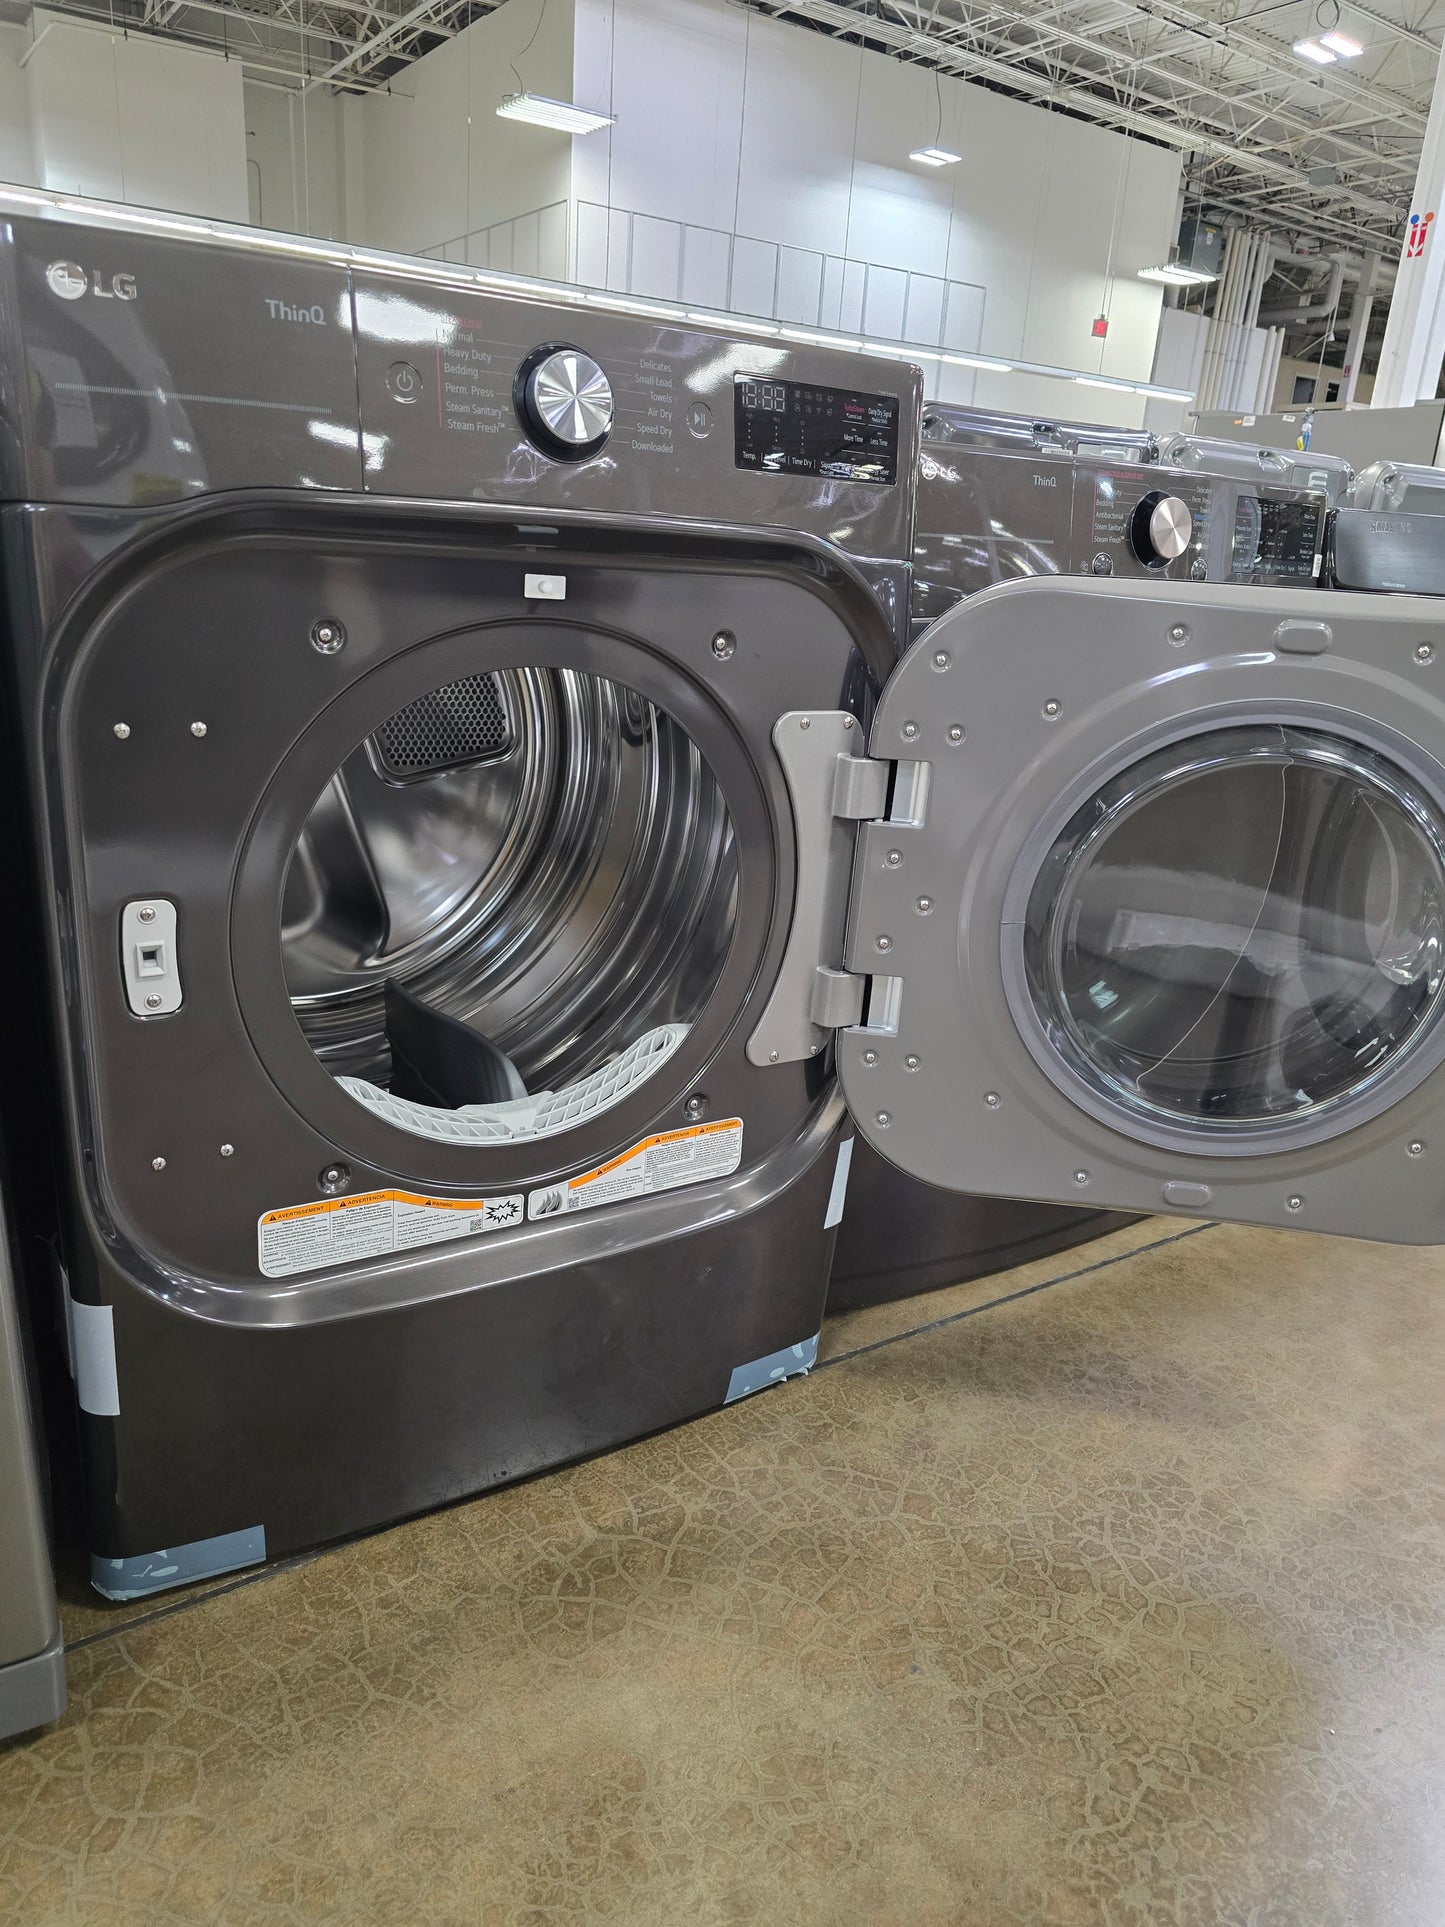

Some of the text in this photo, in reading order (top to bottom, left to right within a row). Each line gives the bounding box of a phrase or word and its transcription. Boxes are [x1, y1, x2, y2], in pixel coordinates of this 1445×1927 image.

[93, 270, 137, 300] LG
[265, 299, 327, 325] ThinQ
[443, 347, 493, 364] Heavy Duty
[443, 362, 479, 379] Bedding
[640, 358, 672, 373] Delicates
[634, 373, 673, 389] Small Load
[445, 382, 495, 398] Perm. Press
[649, 390, 673, 404] Towels
[446, 401, 471, 413] Steam
[648, 407, 673, 422] Air Dry
[447, 418, 475, 431] Steam
[636, 422, 673, 439] Speed Dry
[843, 433, 864, 443] More Time
[879, 438, 889, 447] Time
[631, 439, 674, 454] Downloaded
[791, 457, 814, 469] Time Dry
[1033, 474, 1057, 488] ThinQ
[1096, 499, 1115, 509] Bedding
[1095, 510, 1124, 520] Antibacterial
[1094, 521, 1108, 531] Steam
[1093, 535, 1109, 544] Steam
[347, 1193, 386, 1206] ADVERTENCIA
[277, 1205, 324, 1219] AVERTISSEMENT
